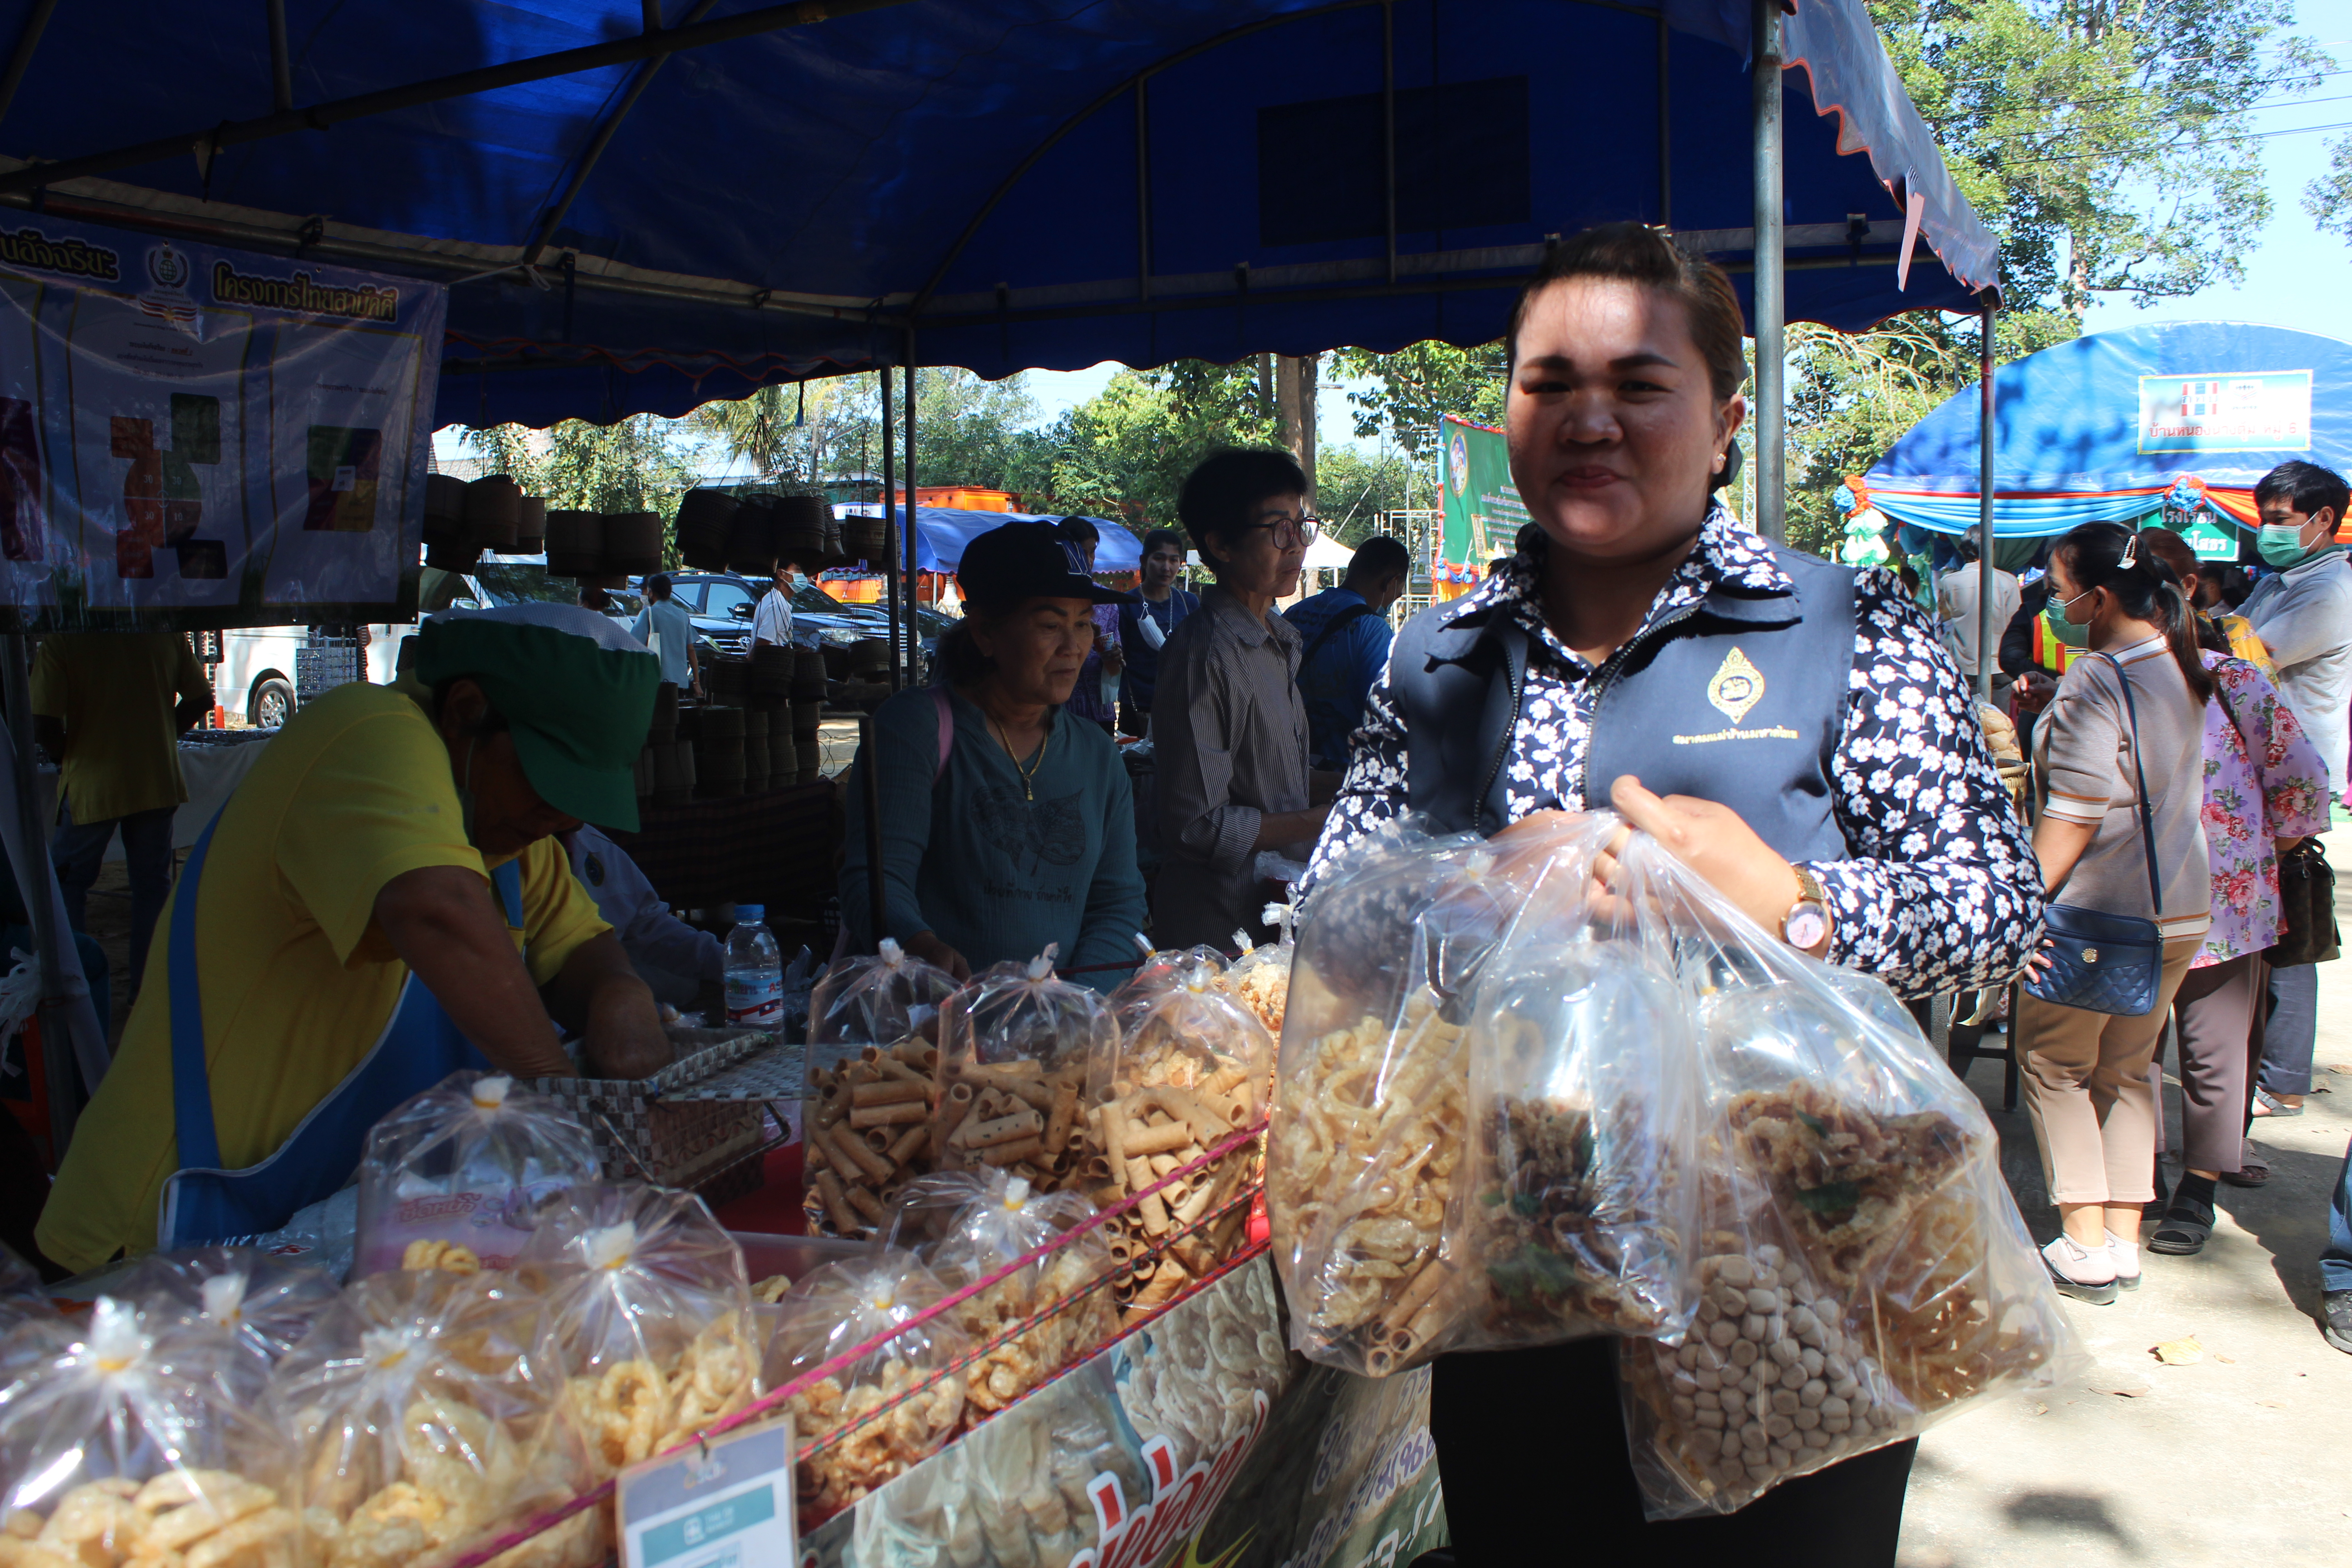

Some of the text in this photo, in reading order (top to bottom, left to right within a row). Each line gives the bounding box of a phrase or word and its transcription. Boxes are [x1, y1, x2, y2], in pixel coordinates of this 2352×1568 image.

[216, 265, 395, 318] โครงการไทยสามัคคี
[2289, 422, 2297, 434] 6
[143, 475, 181, 485] 30 30
[145, 511, 182, 521] 30 10
[2161, 504, 2218, 524] โรงเรยน
